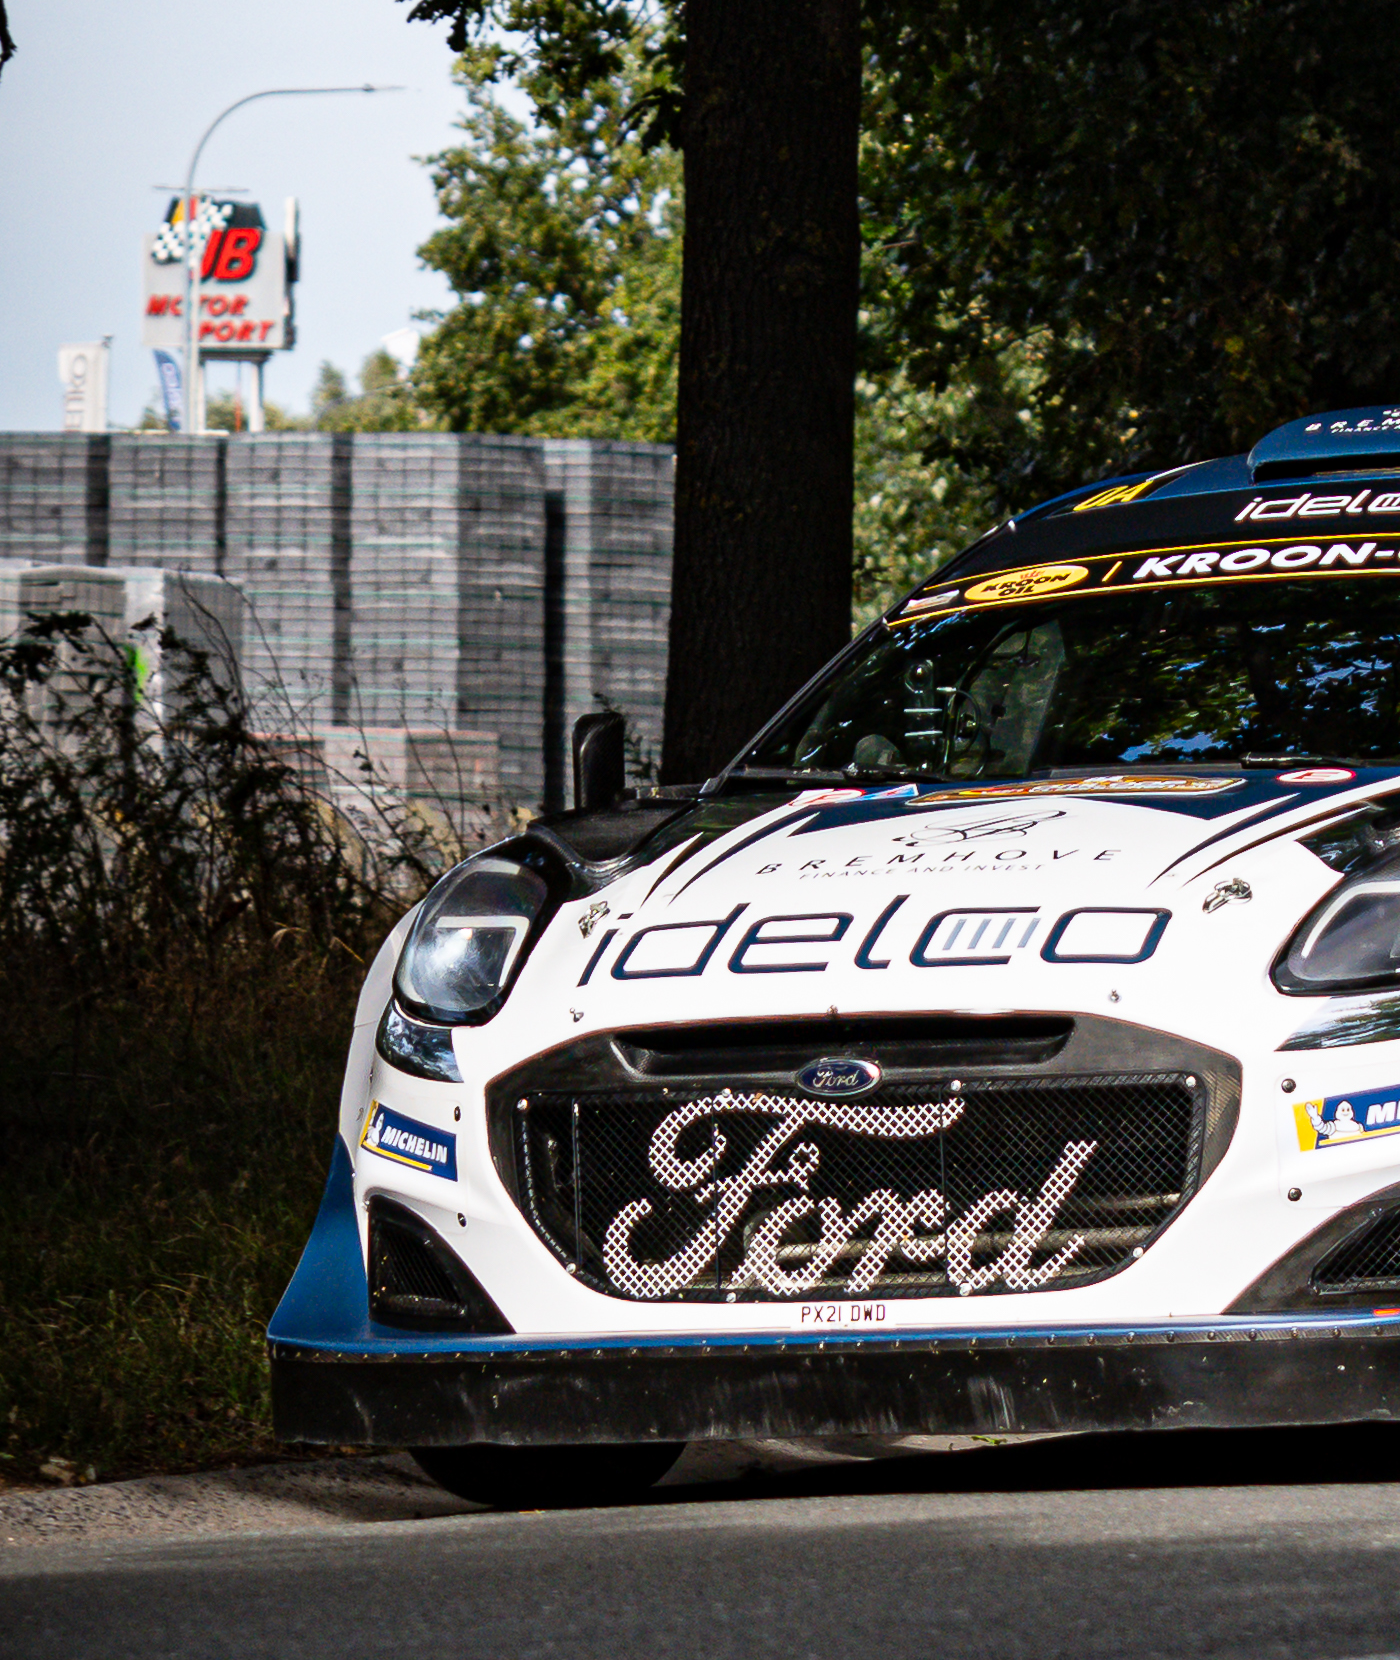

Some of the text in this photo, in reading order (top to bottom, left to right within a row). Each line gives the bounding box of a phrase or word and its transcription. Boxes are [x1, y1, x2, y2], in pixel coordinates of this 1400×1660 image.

[190, 319, 275, 342] PORT
[981, 572, 1071, 593] KROON
[999, 585, 1036, 597] OIL
[755, 849, 1121, 875] BREMHOVE
[799, 862, 1046, 880] FINANCE AND INVEST
[812, 1065, 860, 1088] Ford
[380, 1125, 448, 1164] MICHELIN
[603, 1094, 1098, 1298] Ford
[801, 1304, 886, 1323] PX21 DWD
